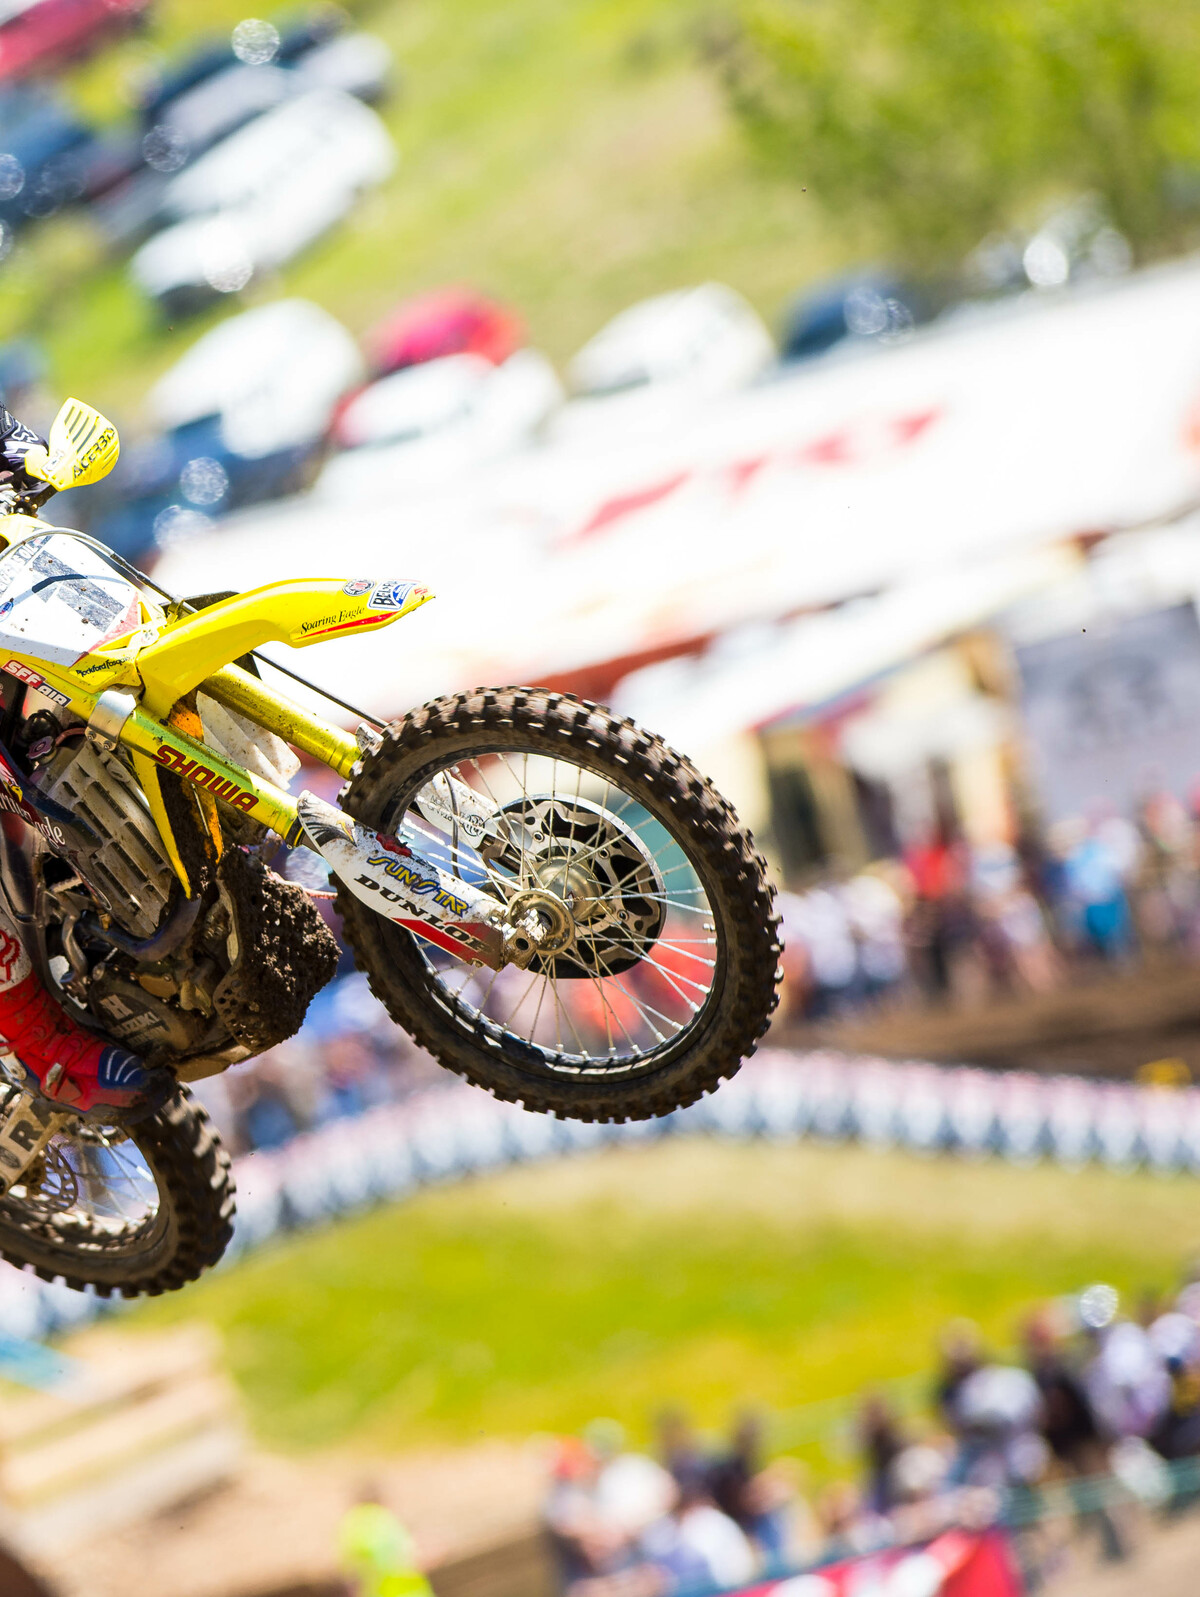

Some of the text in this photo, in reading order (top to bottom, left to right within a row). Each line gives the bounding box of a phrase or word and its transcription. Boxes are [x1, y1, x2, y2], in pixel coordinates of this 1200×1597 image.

[301, 615, 337, 635] Soaring
[4, 660, 67, 705] SFF AIR
[151, 745, 259, 812] SHOWA
